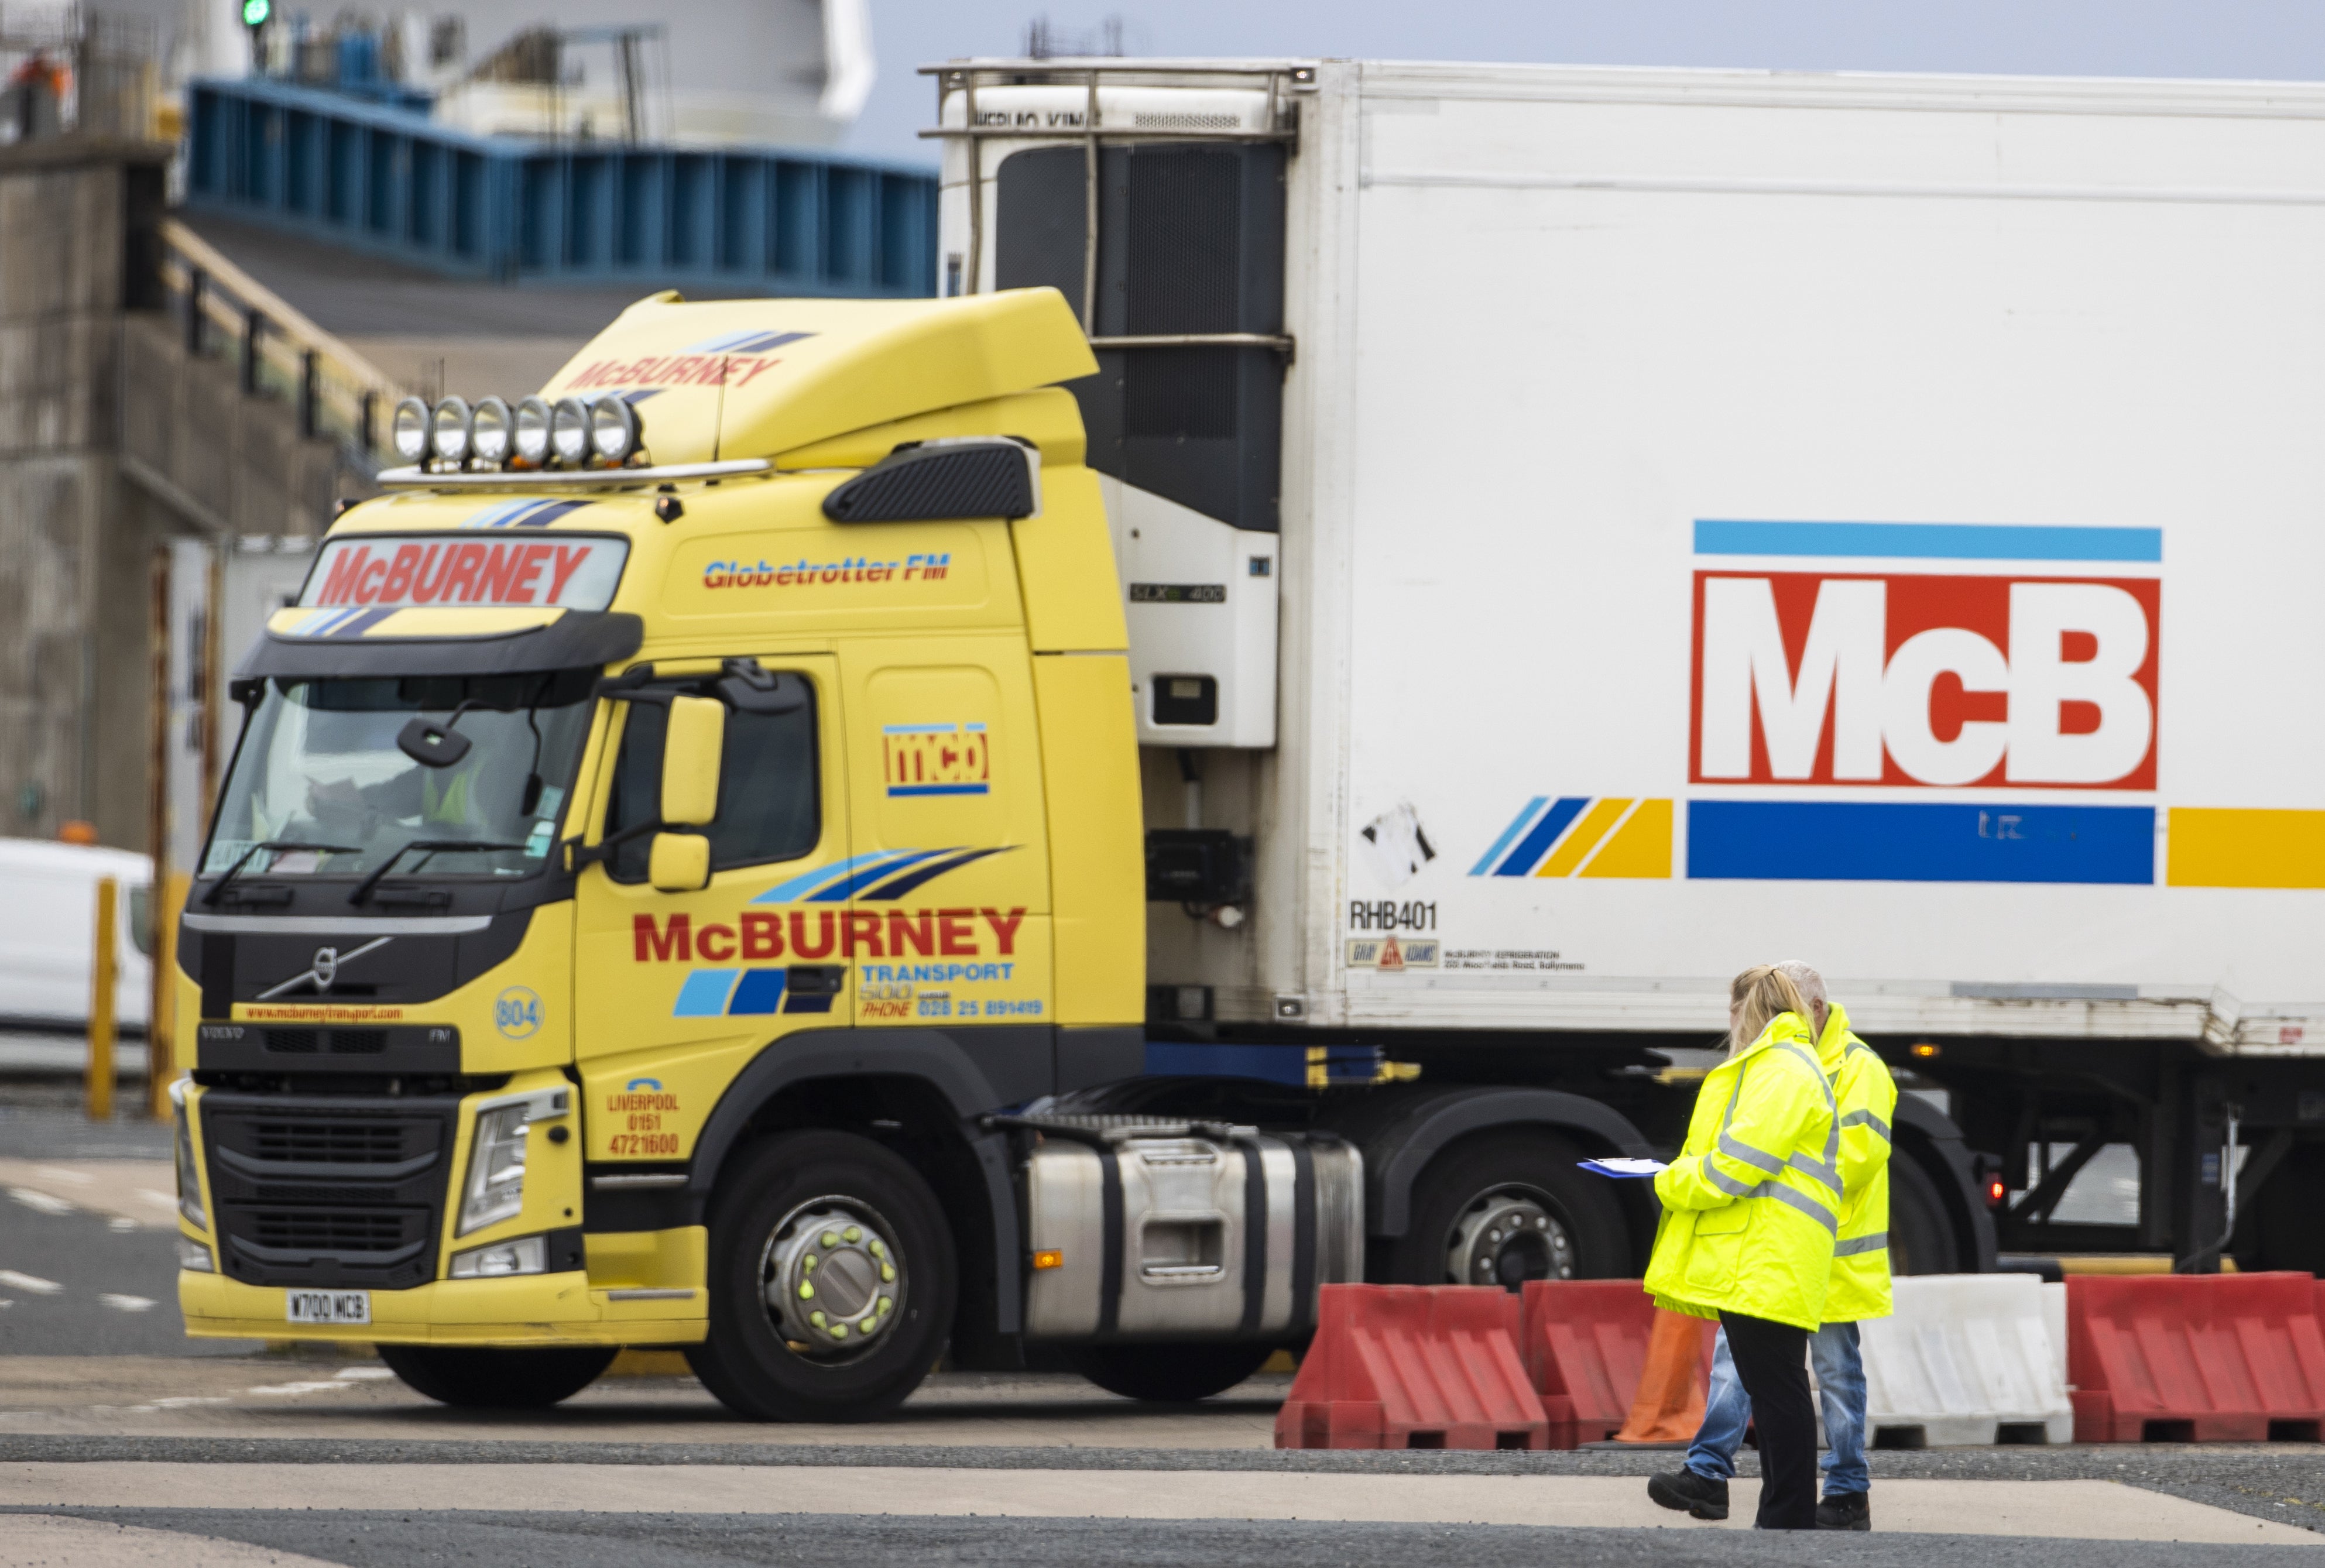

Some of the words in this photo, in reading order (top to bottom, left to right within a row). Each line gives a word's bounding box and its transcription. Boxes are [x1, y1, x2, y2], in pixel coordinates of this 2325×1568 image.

[564, 354, 783, 390] McBURNEY
[317, 543, 591, 606] McBURNEY
[704, 557, 900, 589] Globetrotter
[904, 553, 952, 581] FM
[1700, 576, 2153, 787] McB
[1350, 900, 1437, 931] RHB401
[633, 907, 1027, 963] McBURNEY
[1405, 944, 1435, 962] ADAMS
[862, 963, 1014, 982] TRANSPORT
[496, 999, 538, 1027] 804
[861, 1001, 911, 1017] PHONE
[918, 1000, 952, 1016] 028
[958, 999, 979, 1015] 25
[202, 1026, 245, 1041] VOLVO
[429, 1028, 451, 1042] FM
[607, 1093, 680, 1111] LIVERPOOL
[627, 1113, 661, 1131] 0151
[610, 1133, 679, 1154] 4721600
